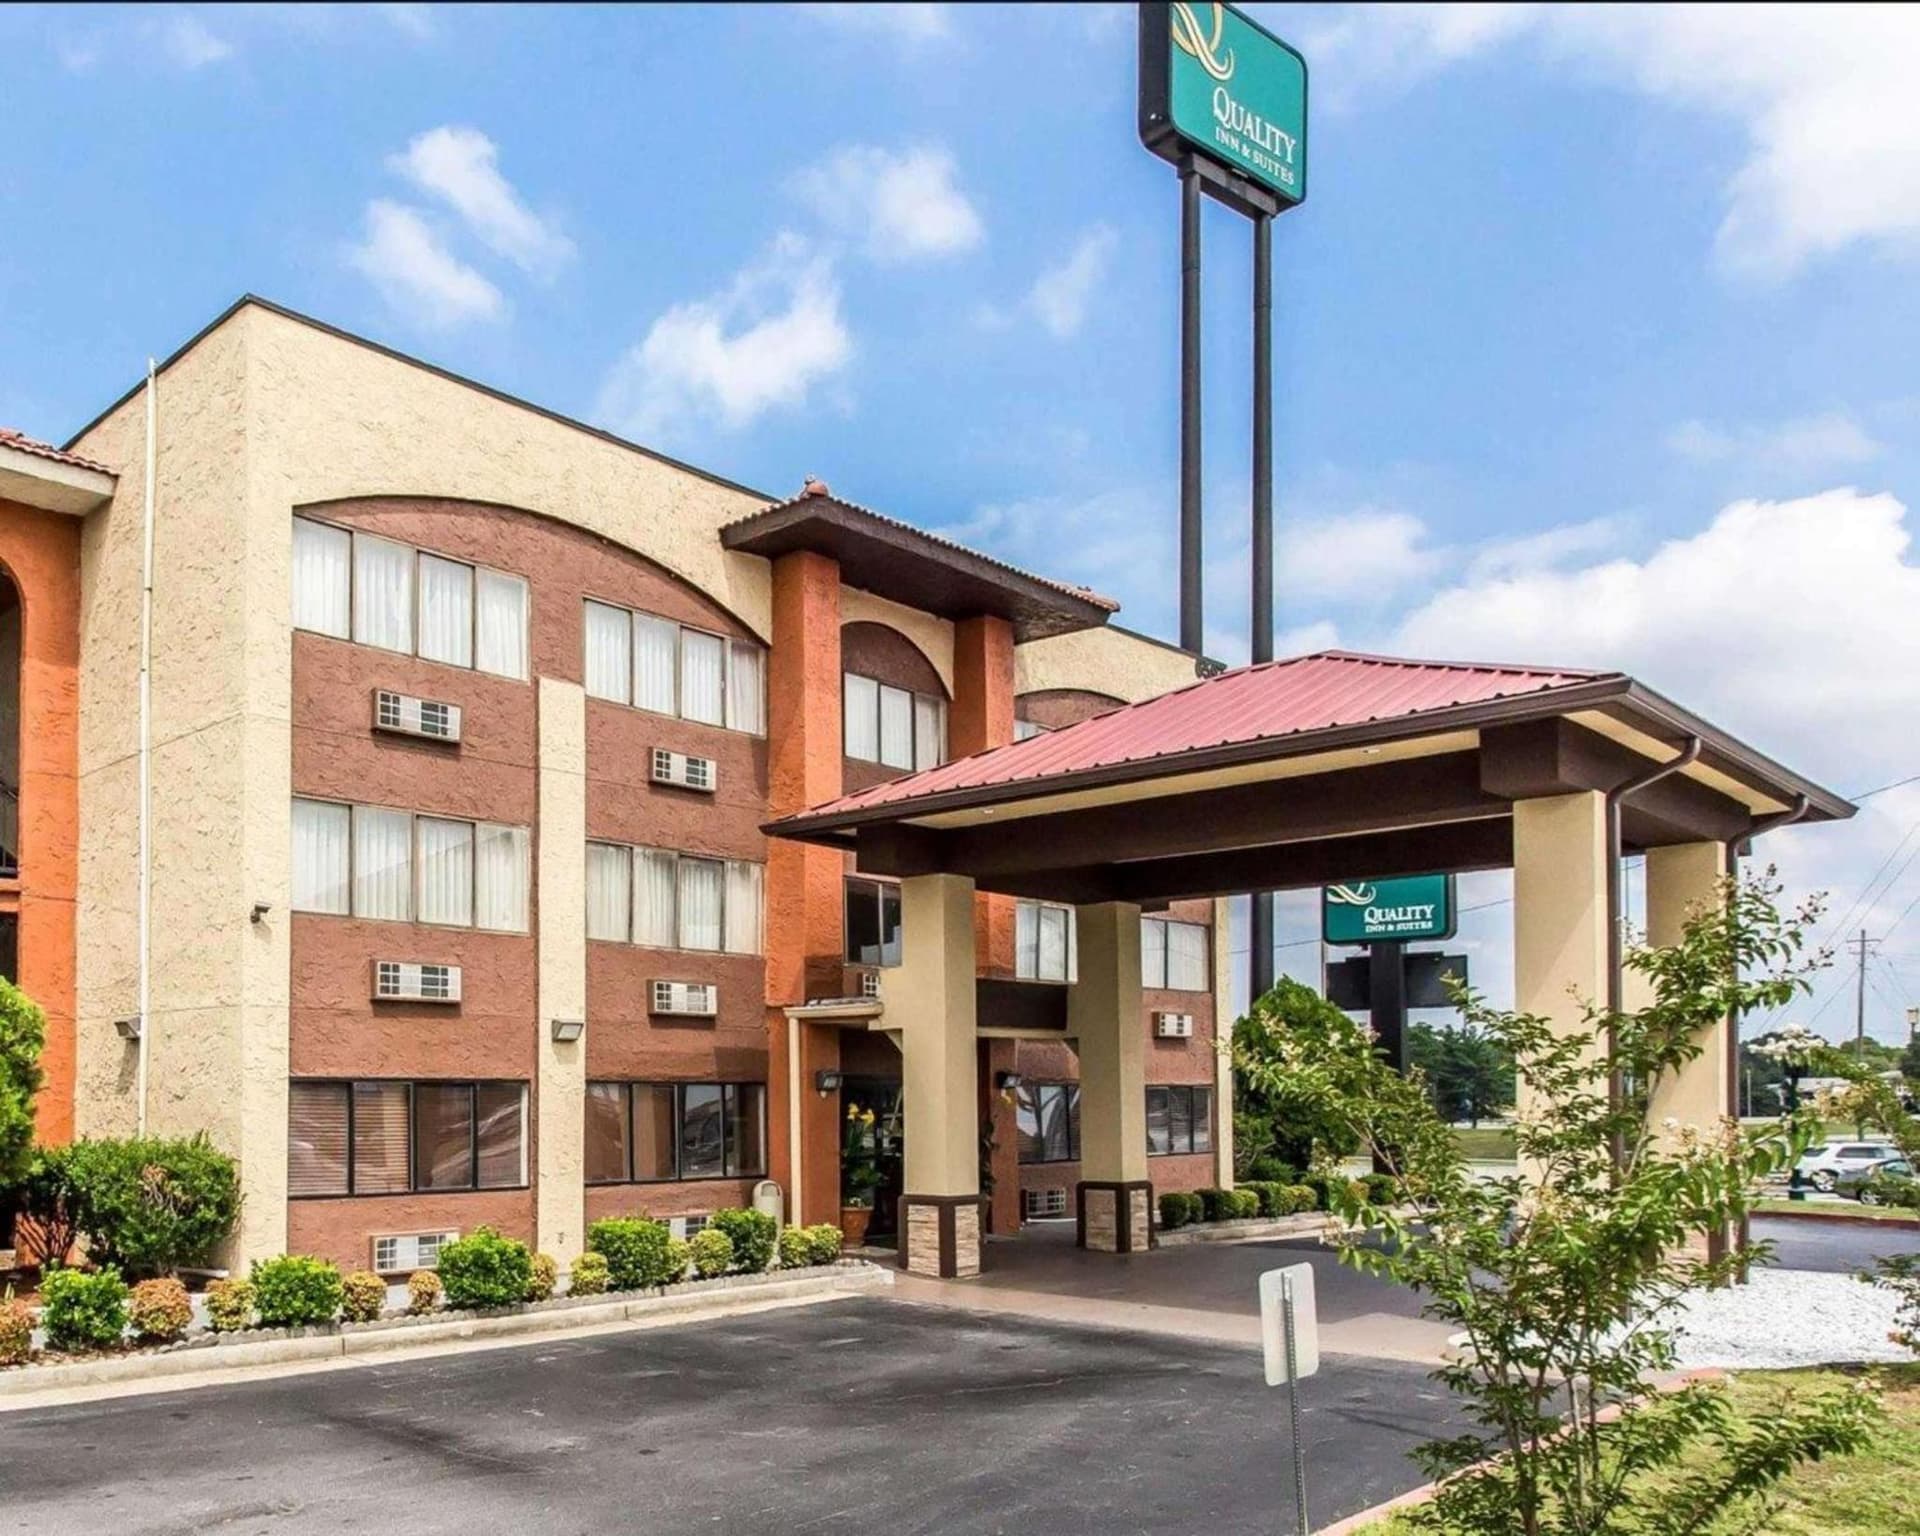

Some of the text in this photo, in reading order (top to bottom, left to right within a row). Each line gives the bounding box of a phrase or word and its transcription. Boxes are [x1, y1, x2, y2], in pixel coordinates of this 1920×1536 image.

[1213, 87, 1296, 164] QUALITY
[1215, 126, 1294, 185] INN & SUITES
[1364, 904, 1435, 924] QUALITY
[1365, 921, 1432, 933] INN & SUITES
